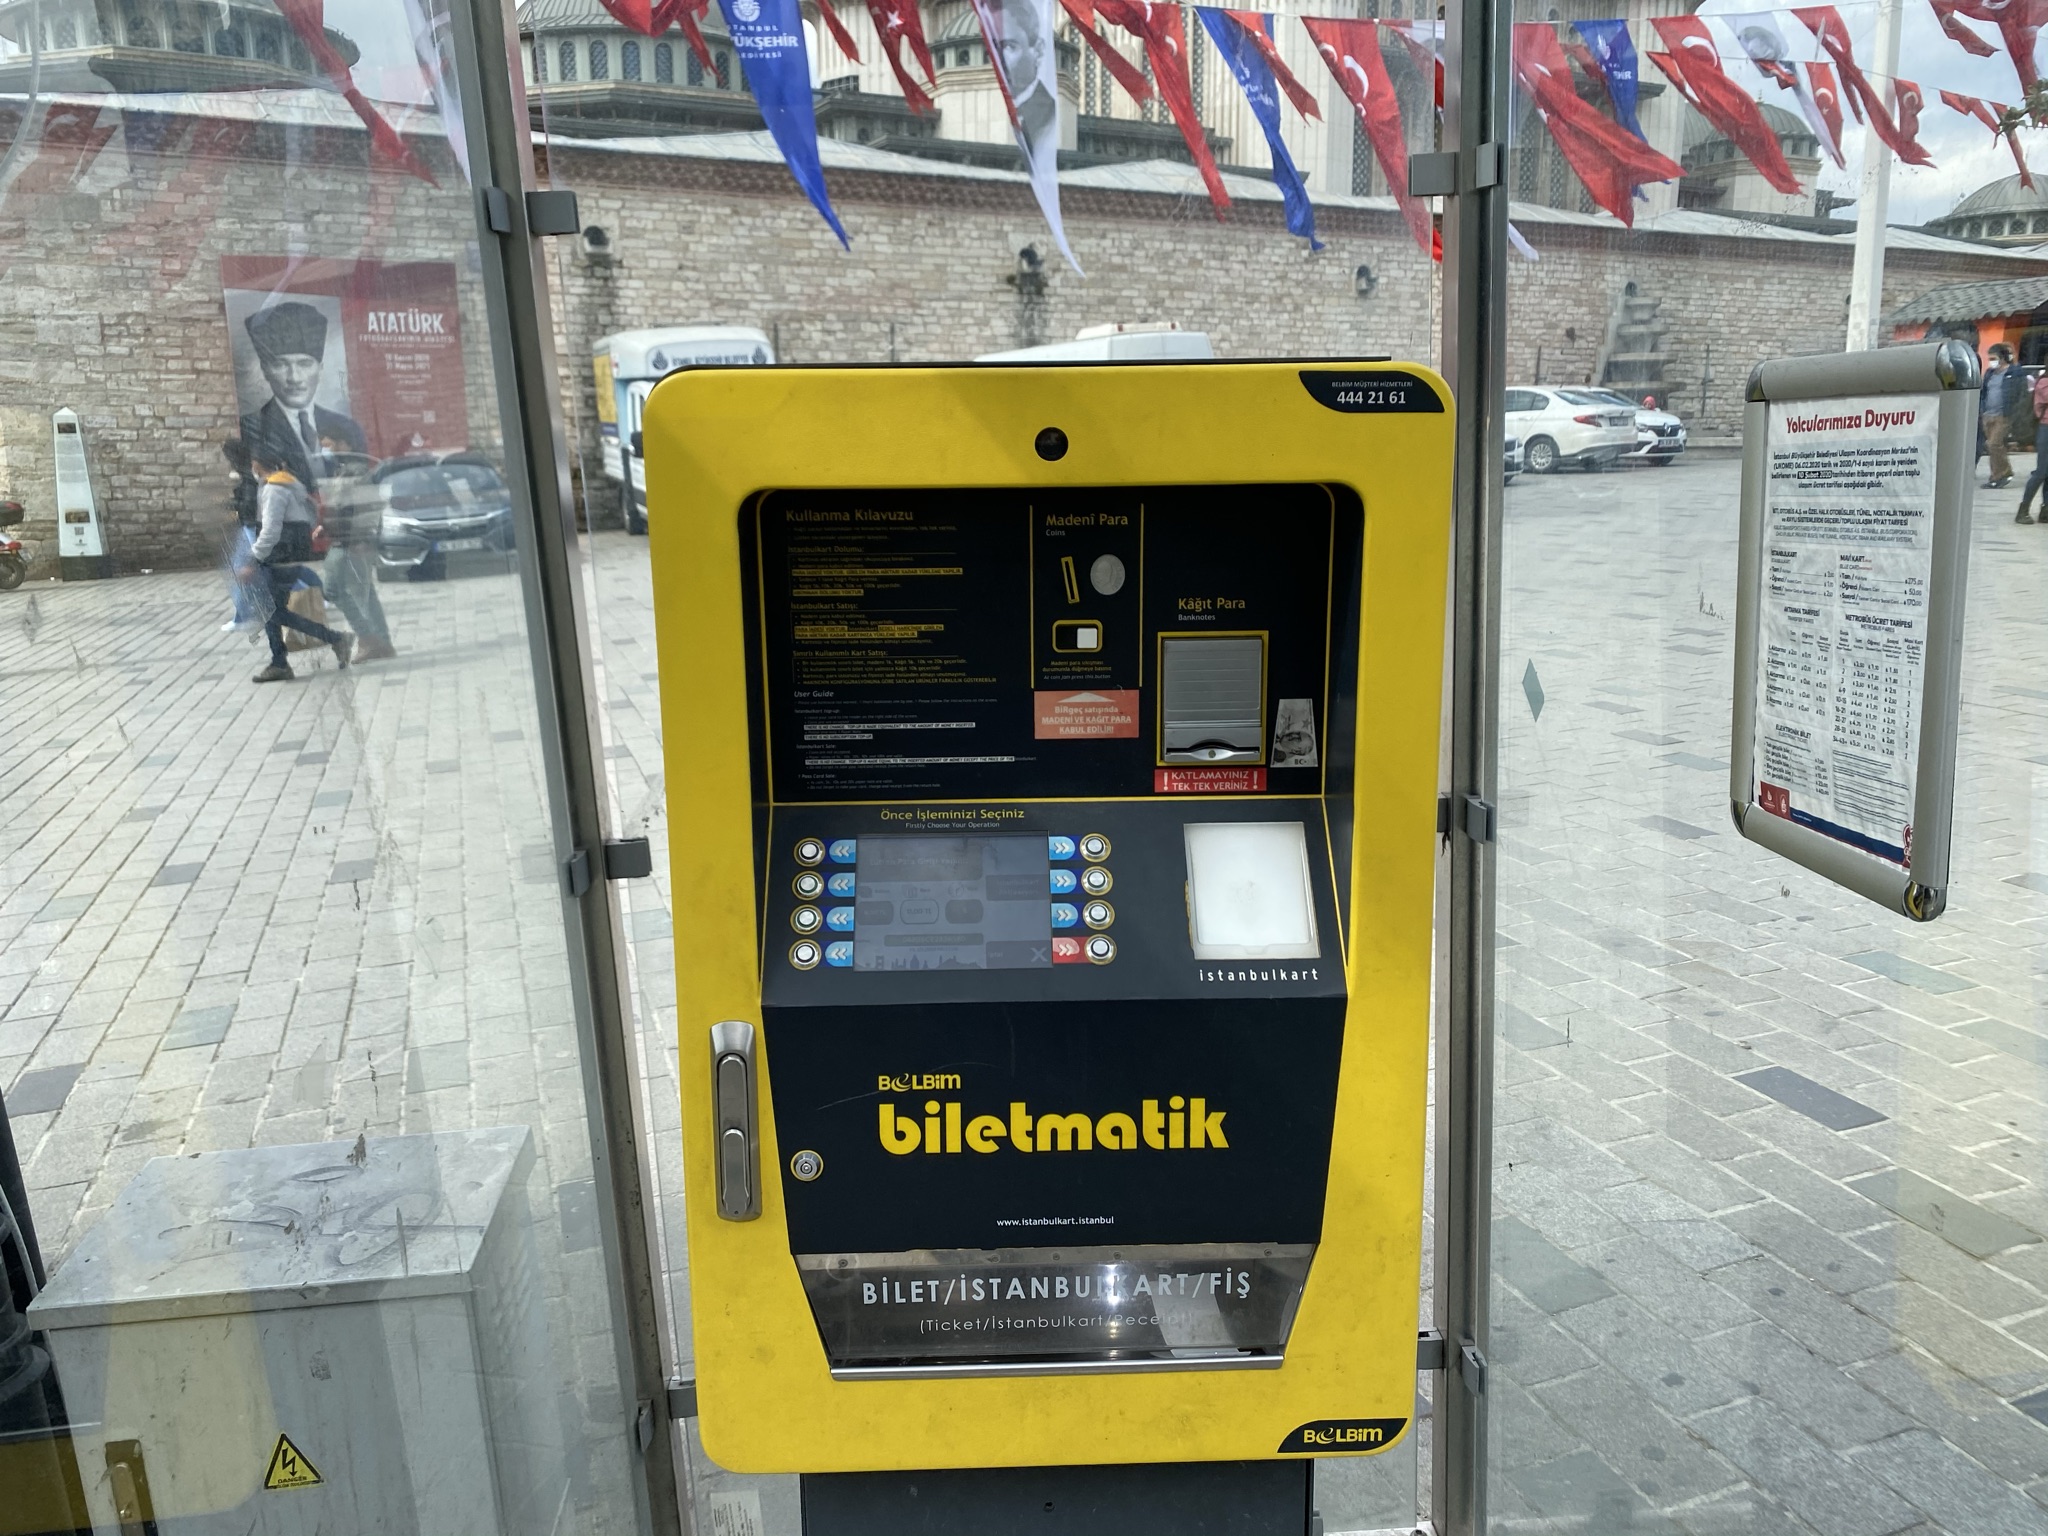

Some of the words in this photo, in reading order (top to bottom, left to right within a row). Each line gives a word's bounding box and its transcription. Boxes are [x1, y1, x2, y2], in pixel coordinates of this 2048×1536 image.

[368, 309, 445, 333] ATATÜRK
[1354, 380, 1379, 389] MÜŞTERİ
[1337, 391, 1363, 404] 444
[1368, 391, 1384, 404] 21
[1389, 391, 1406, 404] 61
[1786, 414, 1862, 434] Yolcularımıza
[1864, 408, 1916, 431] Duyuru
[786, 509, 850, 521] Kullanma
[854, 508, 914, 521] Kılavuzu
[1046, 513, 1096, 526] Madenî
[1099, 513, 1128, 526] Para
[1046, 529, 1066, 537] Coins
[1178, 597, 1213, 612] Kâğıt
[1217, 597, 1246, 609] Para
[794, 690, 810, 698] User
[1055, 706, 1082, 715] BİRgeç
[1085, 705, 1118, 714] satışında
[1111, 715, 1132, 723] PARA
[1172, 771, 1249, 780] KATLAMAYINIZ
[1172, 782, 1190, 791] TEK
[1193, 782, 1210, 790] TEK
[1213, 780, 1248, 790] VERİNİZ
[881, 808, 912, 820] Önce
[917, 808, 976, 822] İşleminizi
[980, 808, 1024, 821] Seçiniz
[906, 822, 925, 830] Firstly
[951, 821, 966, 829] Your
[968, 820, 1000, 829] Operation
[1200, 967, 1319, 982] istanbulkart
[879, 1095, 1229, 1155] biletmatik
[996, 1216, 1114, 1226] www.istanbulkart.istanbul
